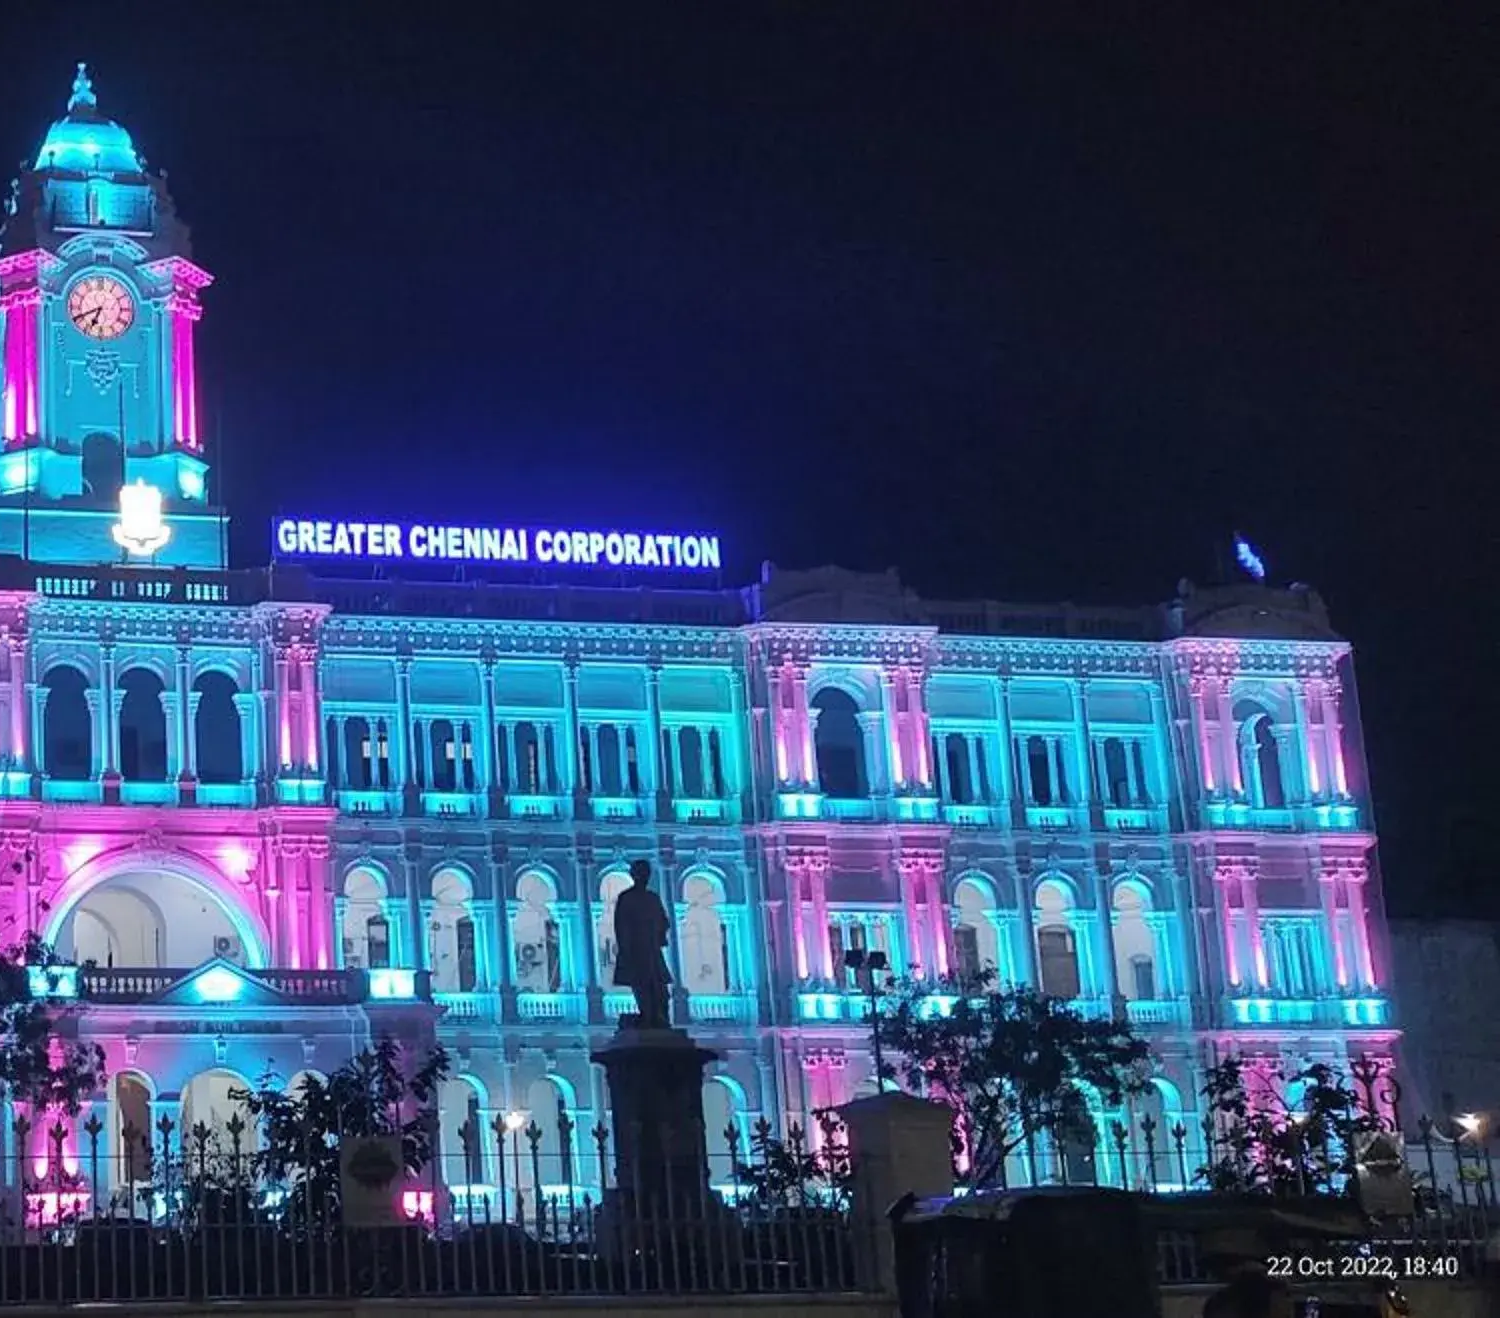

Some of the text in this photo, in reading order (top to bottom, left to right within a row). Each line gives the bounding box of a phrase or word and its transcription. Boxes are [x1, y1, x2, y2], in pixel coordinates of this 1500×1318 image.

[278, 520, 722, 568] GREATER CHENNAI CORPORATION
